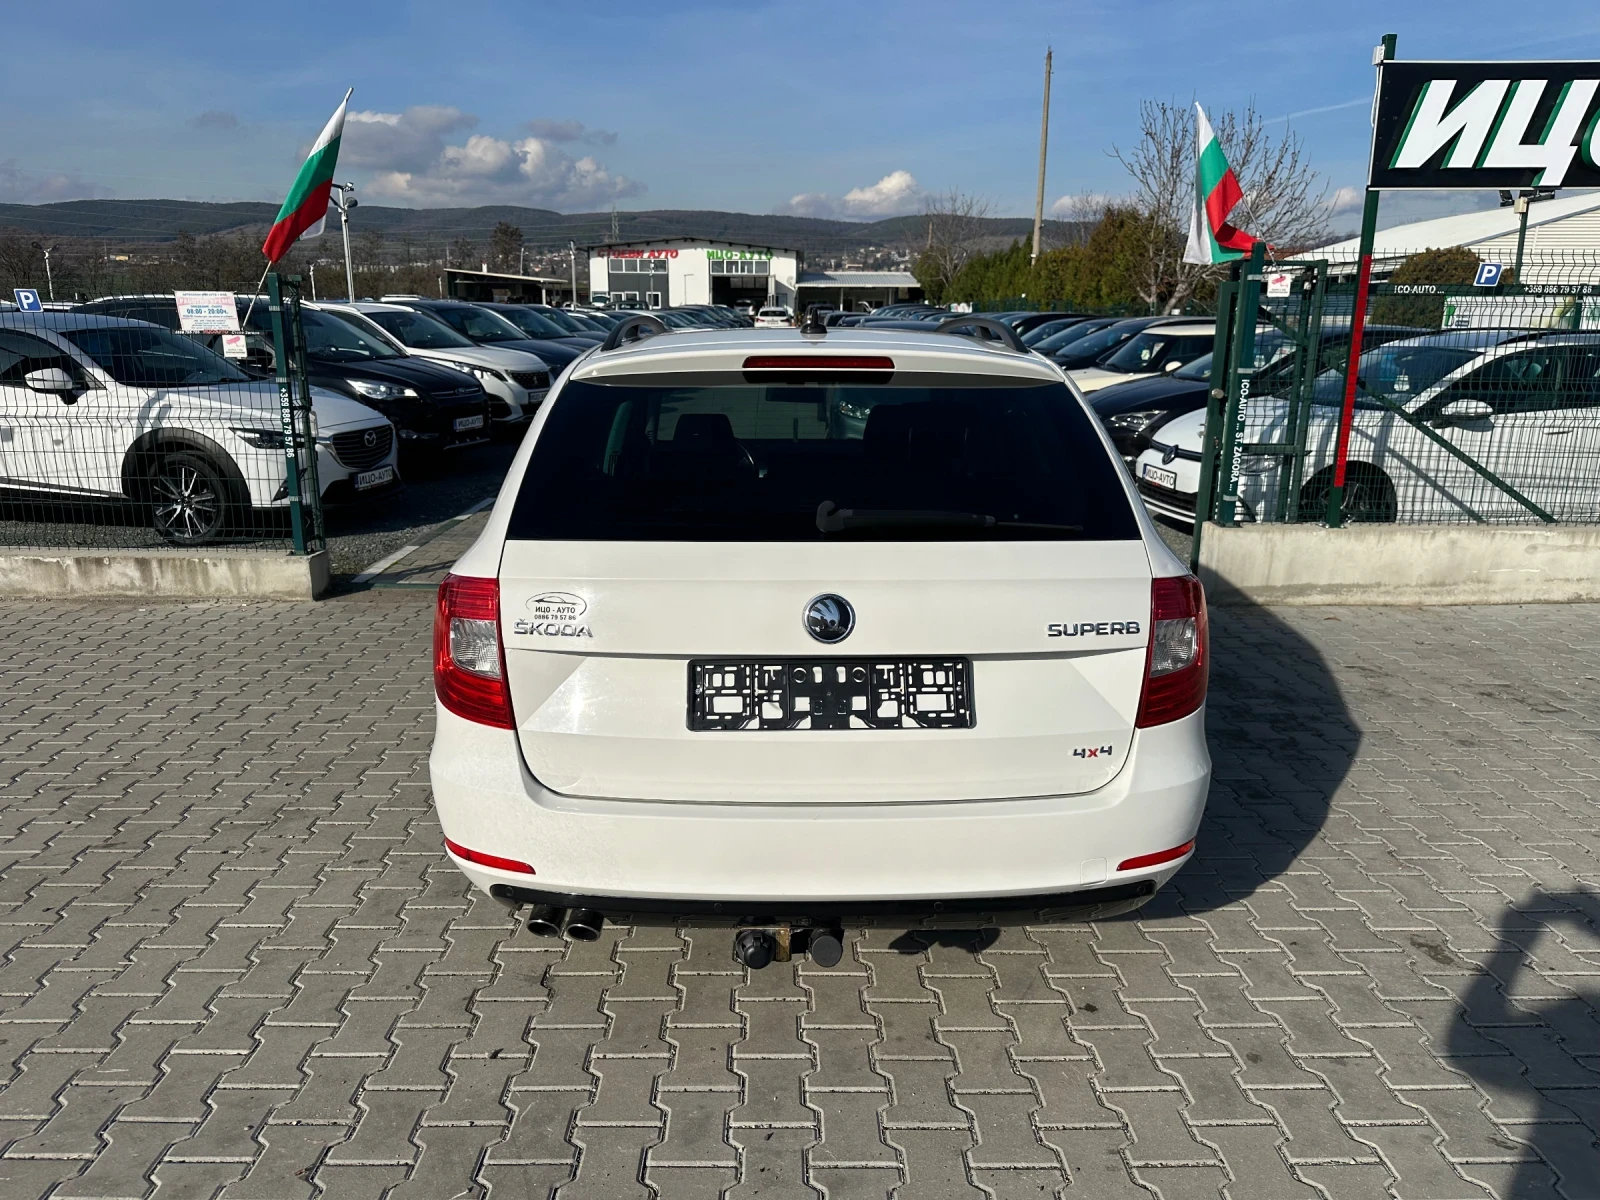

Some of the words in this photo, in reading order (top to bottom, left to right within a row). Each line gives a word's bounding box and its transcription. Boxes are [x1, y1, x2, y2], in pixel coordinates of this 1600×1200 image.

[1388, 79, 1600, 187] ИЦ
[648, 249, 679, 259] АУТО
[1480, 265, 1497, 283] P
[1523, 284, 1543, 294] +359
[1560, 285, 1570, 294] 79
[1571, 285, 1581, 294] 57
[1582, 285, 1593, 294] 86
[19, 291, 34, 309] P
[280, 387, 290, 407] +359
[281, 408, 291, 423] 886
[283, 424, 293, 435] 79
[284, 436, 294, 446] 57
[1234, 432, 1244, 445] ST.
[286, 447, 295, 458] 86
[1230, 446, 1243, 483] ZAGORA
[359, 468, 393, 485] ИЦО-АУТО
[535, 606, 551, 614] ИЦО
[556, 606, 576, 614] АУТО
[513, 618, 594, 638] ŠKODA
[1047, 621, 1141, 637] SUPERB
